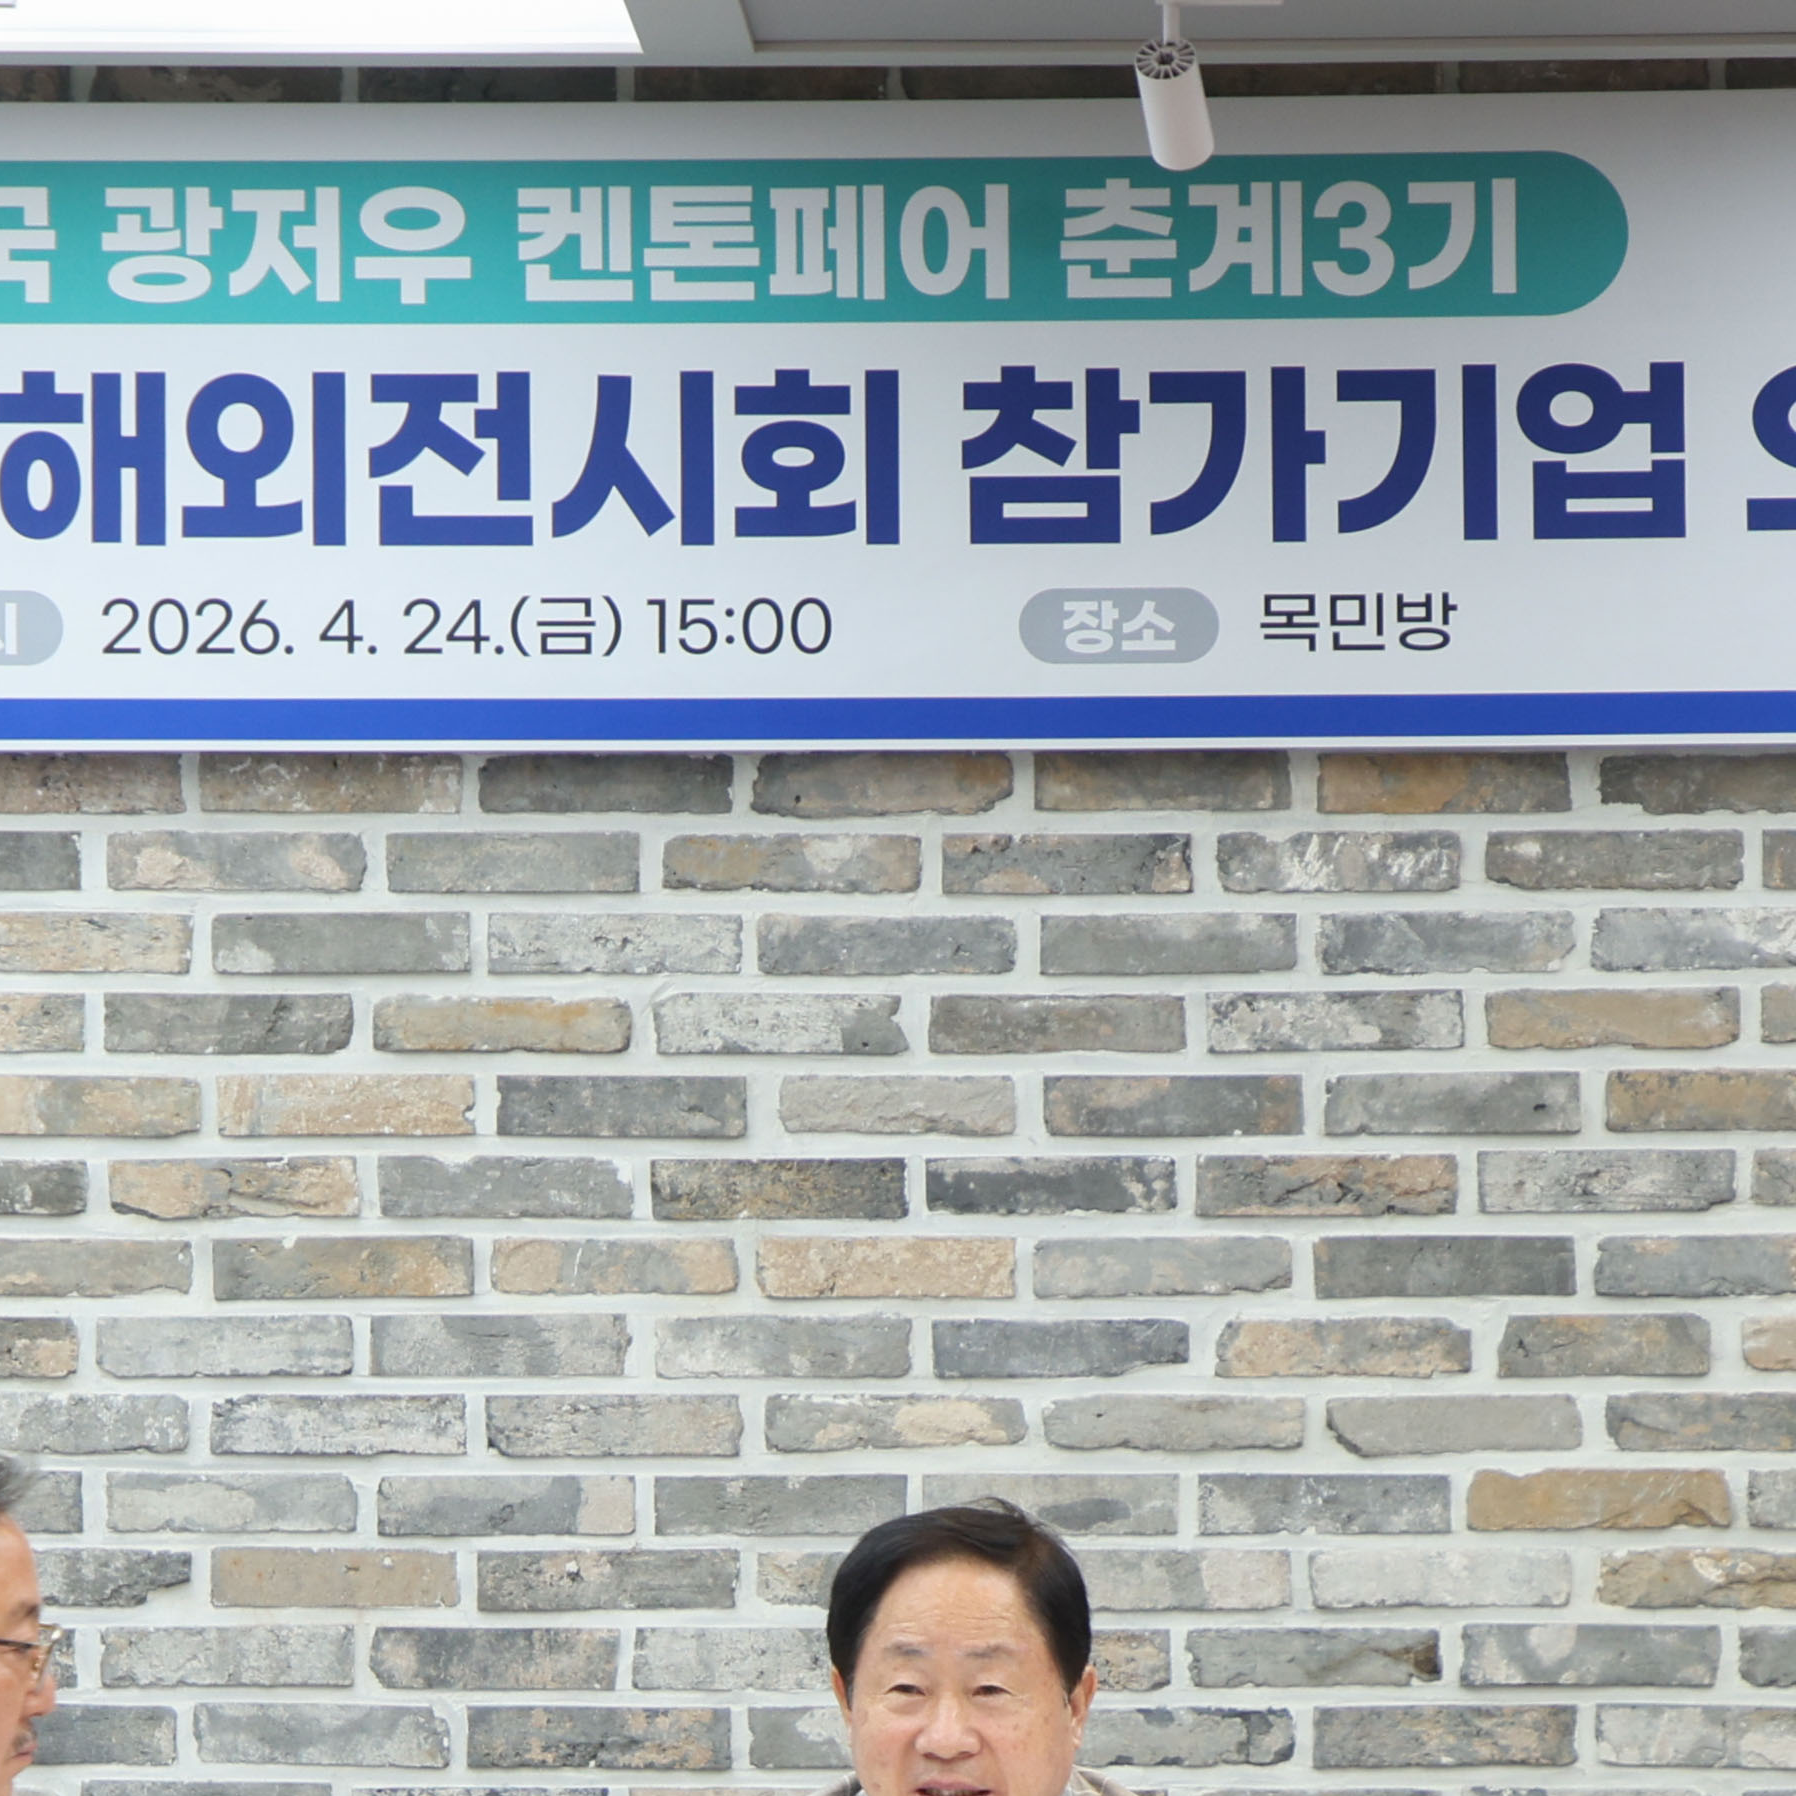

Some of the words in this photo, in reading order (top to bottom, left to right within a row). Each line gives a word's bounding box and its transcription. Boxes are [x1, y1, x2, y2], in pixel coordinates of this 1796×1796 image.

[102, 186, 472, 305] 광저우
[518, 183, 1011, 302] 켄톤페어
[1060, 177, 1518, 300] 춘계3기
[961, 360, 1687, 545] 참가기업
[103, 598, 294, 655] 2026.
[319, 600, 377, 655] 4.
[404, 595, 622, 657] 24.(금)
[647, 597, 832, 655] 15:00
[1062, 600, 1176, 654] 장소
[1260, 592, 1458, 652] 목민방
